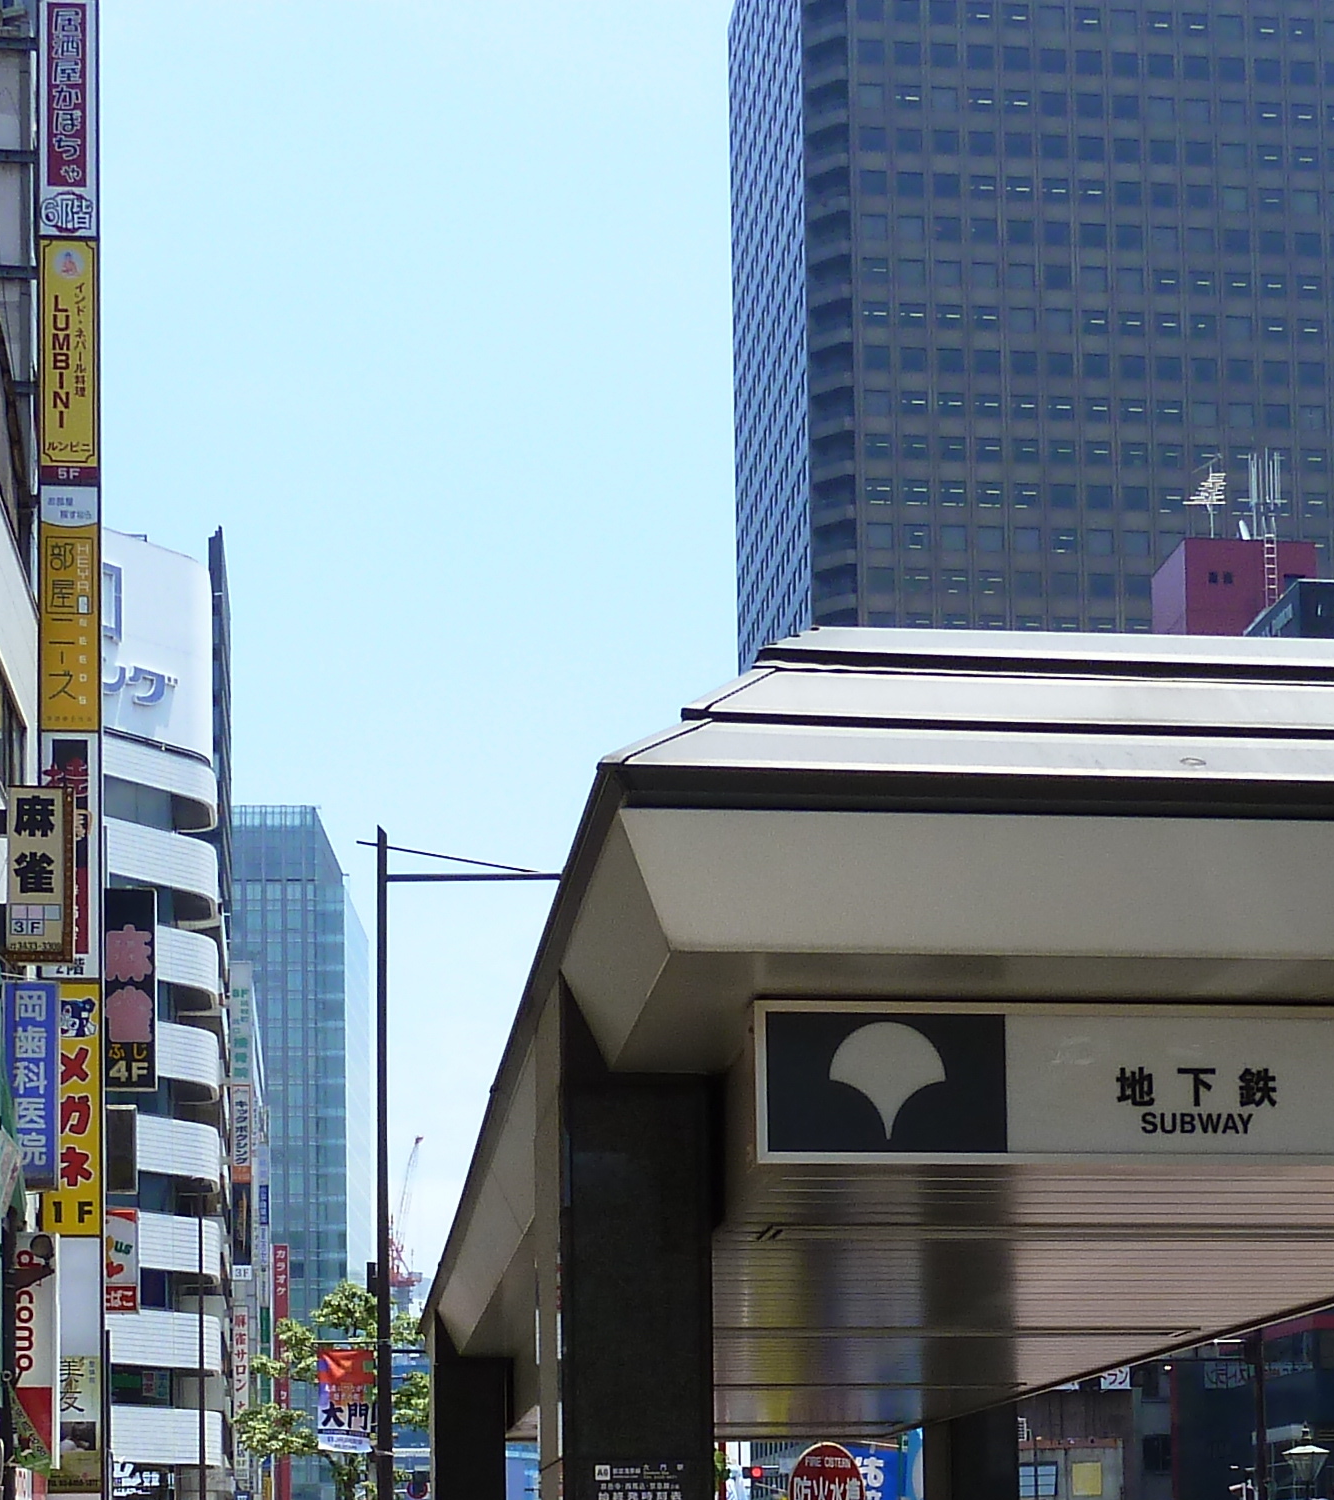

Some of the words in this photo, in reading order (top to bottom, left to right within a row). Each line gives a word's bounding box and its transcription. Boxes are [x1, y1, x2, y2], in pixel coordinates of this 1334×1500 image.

[51, 8, 83, 184] 居酒屋かぼちゃ
[41, 198, 95, 232] 6階
[51, 294, 71, 428] LUMBINI
[47, 440, 91, 454] ルンビニ
[57, 468, 81, 480] 5F
[13, 794, 55, 894] 麻雀
[13, 918, 41, 934] 3F
[107, 1042, 147, 1058] ふじ
[13, 988, 47, 1166] 岡歯科医院
[107, 1060, 149, 1082] 4F
[1115, 1066, 1279, 1108] 地下鉄
[59, 1042, 95, 1190] メガネ
[1139, 1110, 1255, 1136] SUBWAY
[51, 1200, 97, 1224] 1F
[235, 1268, 249, 1278] 3F
[275, 1250, 289, 1296] カラオケ
[15, 1248, 41, 1374] dcomo
[321, 1400, 369, 1432] 大門
